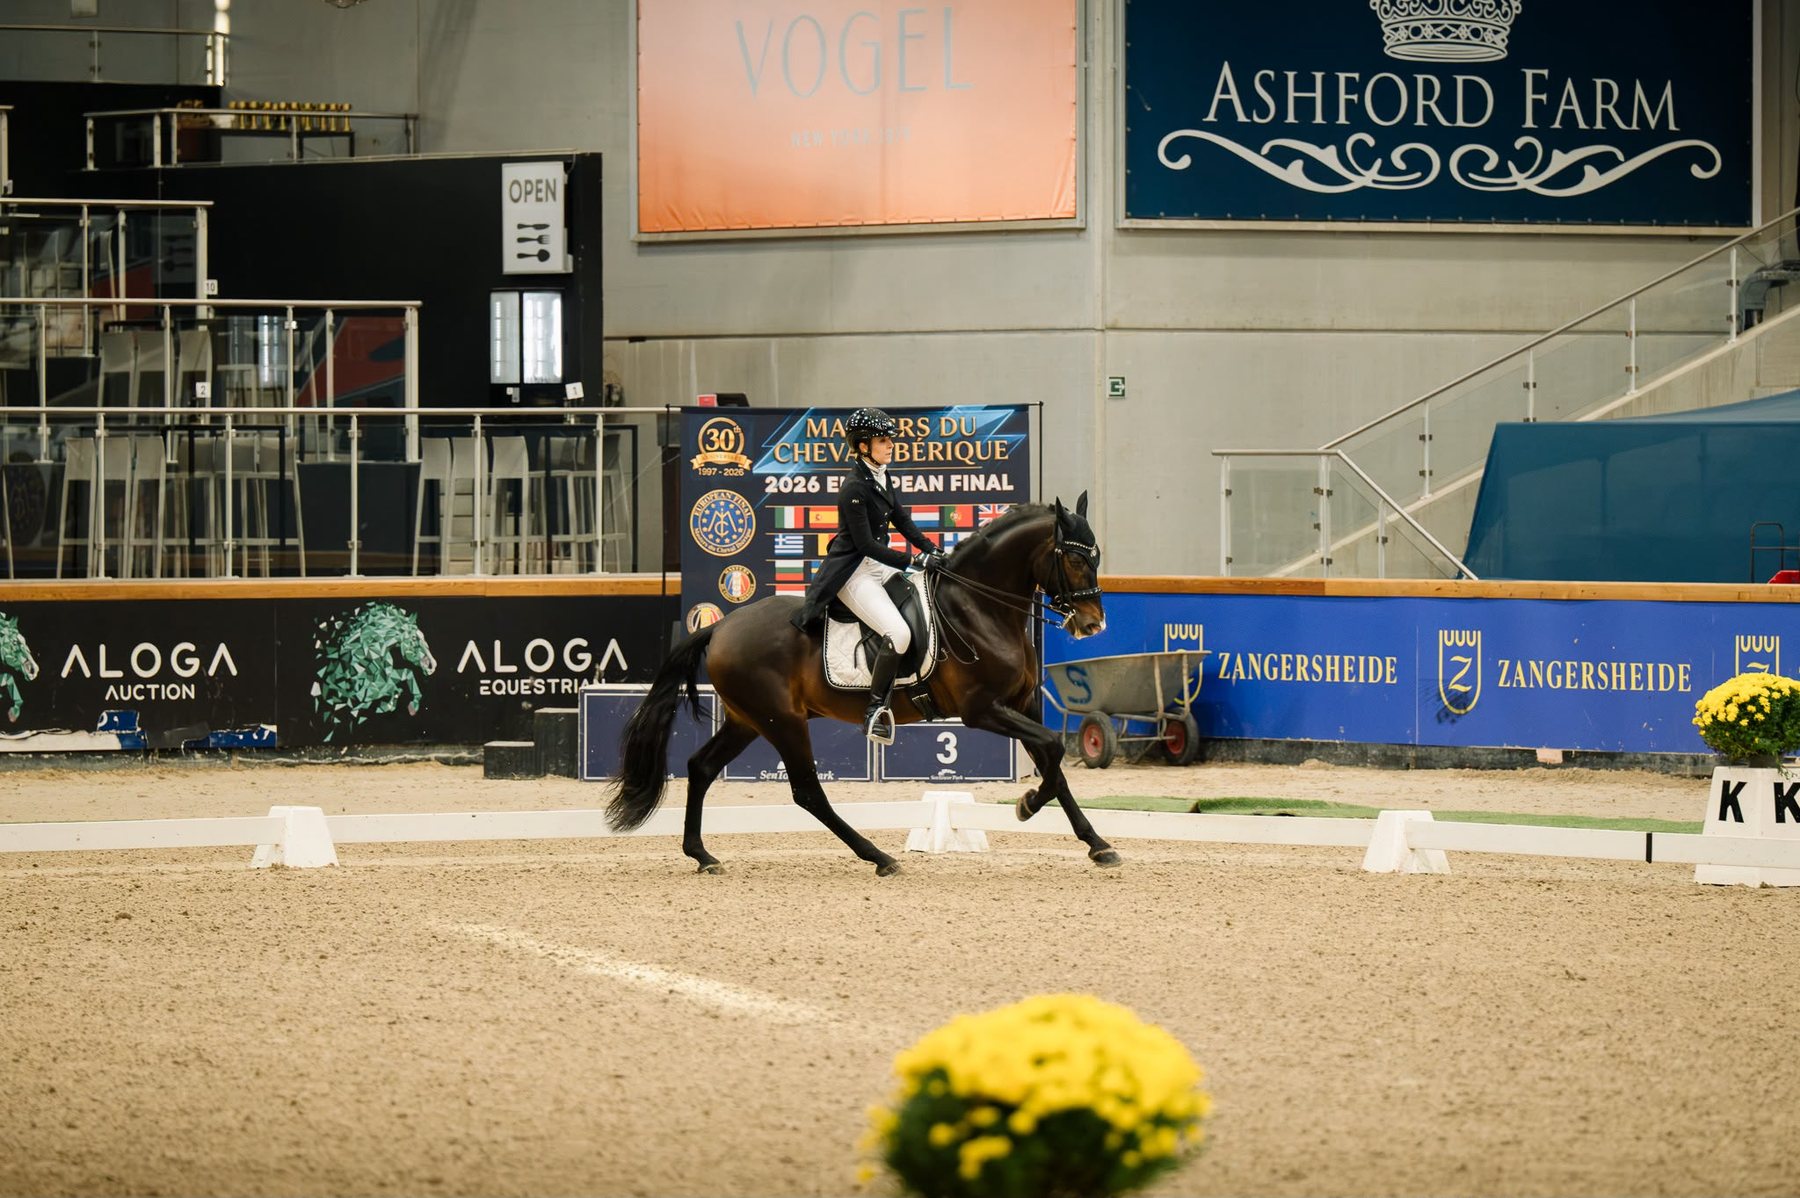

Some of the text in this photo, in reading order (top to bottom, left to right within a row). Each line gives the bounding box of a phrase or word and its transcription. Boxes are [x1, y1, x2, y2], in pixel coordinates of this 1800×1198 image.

[735, 6, 975, 99] VOGEL
[1202, 60, 1680, 131] ASHFORD FARM
[509, 178, 557, 203] OPEN
[200, 385, 206, 395] 2
[806, 416, 977, 439] MARS DU
[773, 436, 1010, 465] CHEVA BÉRIQUE
[698, 467, 718, 476] 1997
[723, 467, 745, 477] 2026
[764, 473, 1015, 494] 2026 EPEAN FINAL
[60, 642, 237, 678] ALOGA
[457, 638, 628, 673] ALOGA
[1218, 652, 1398, 685] ZANGERSHEIDE
[104, 683, 196, 700] AUCTION
[1498, 659, 1693, 692] ZANGERSHEIDE
[936, 731, 958, 765] 3
[1718, 780, 1748, 823] K
[1773, 782, 1800, 824] K
